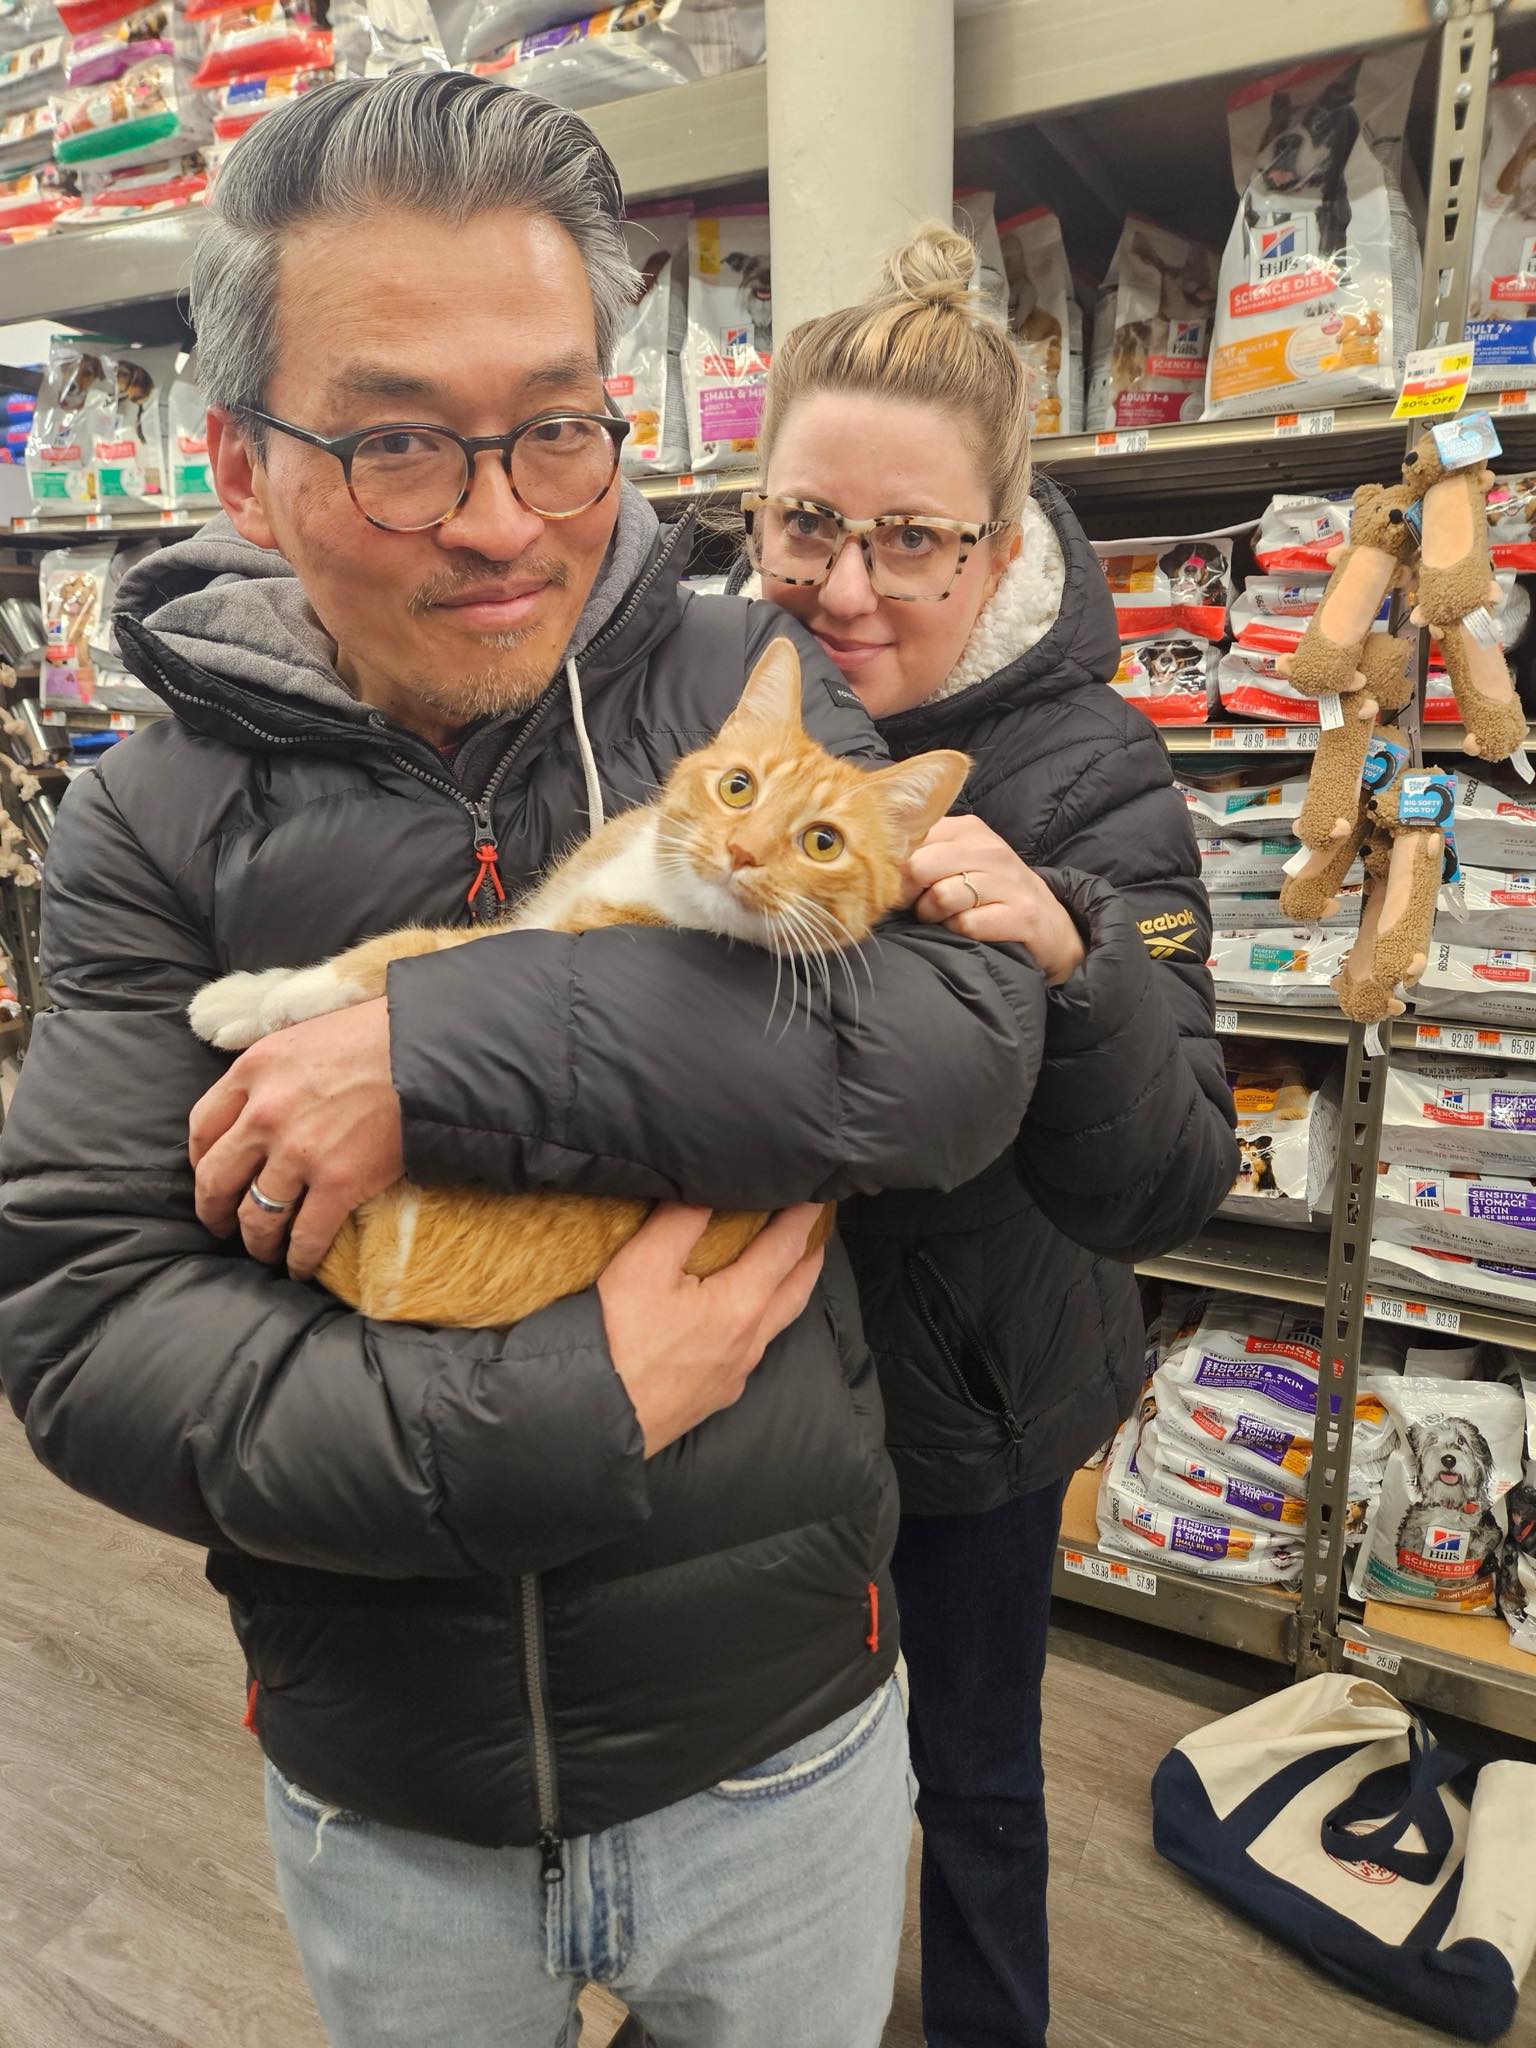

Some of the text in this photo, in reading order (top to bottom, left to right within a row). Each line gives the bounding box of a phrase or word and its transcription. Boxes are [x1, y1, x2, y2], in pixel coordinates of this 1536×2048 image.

[1234, 274, 1328, 306] SCIENCE DIET
[1498, 281, 1536, 292] SCIEN
[1465, 324, 1493, 334] DULT
[1151, 359, 1190, 370] SCIENCE
[704, 390, 735, 401] SMALL
[1119, 393, 1151, 402] ADULT
[1401, 400, 1430, 409] 50%
[1432, 395, 1456, 405] OFF
[1310, 416, 1332, 433] 20.98
[1243, 733, 1264, 748] 48.98
[1297, 732, 1318, 748] 48.98
[1364, 769, 1377, 778] TOY
[1463, 779, 1480, 806] 605822
[1136, 909, 1196, 934] eebok
[1476, 968, 1507, 976] SCIENCE
[1216, 1015, 1236, 1030] 59.98
[1451, 1033, 1474, 1049] 92.98
[1511, 1039, 1535, 1056] 85.98
[1494, 1096, 1536, 1104] SENSITIV
[1472, 1190, 1528, 1200] SENSITIVE
[1472, 1198, 1526, 1207] STOMACH
[1415, 1199, 1440, 1208] Hill's
[1473, 1206, 1509, 1214] & SKIN
[1461, 1236, 1493, 1246] MILLION
[1381, 1301, 1402, 1317] 83.98
[1436, 1312, 1458, 1329] 83.98
[1254, 1342, 1314, 1360] SCIENCE
[1206, 1360, 1265, 1371] SENSITIVE
[1204, 1366, 1261, 1376] STOMACH
[1276, 1374, 1304, 1391] SKIN
[1240, 1417, 1286, 1440] SENSITIVE
[1160, 1485, 1185, 1501] HELPED
[1196, 1504, 1225, 1518] MILLION
[1240, 1489, 1260, 1501] SKIN
[1176, 1524, 1220, 1541] STOMACH
[1177, 1518, 1222, 1534] SENSITIVE
[1175, 1538, 1213, 1552] SMALL BITES
[1184, 1533, 1205, 1544] SKIN
[1404, 1554, 1452, 1572] SCIENCE
[1454, 1563, 1476, 1572] DIET
[1430, 1549, 1460, 1562] Hill's
[1091, 1563, 1109, 1579] 59.98
[1136, 1575, 1155, 1591] 57.98
[1461, 1582, 1490, 1597] SUPPORT
[1376, 1656, 1398, 1672] 25.98
